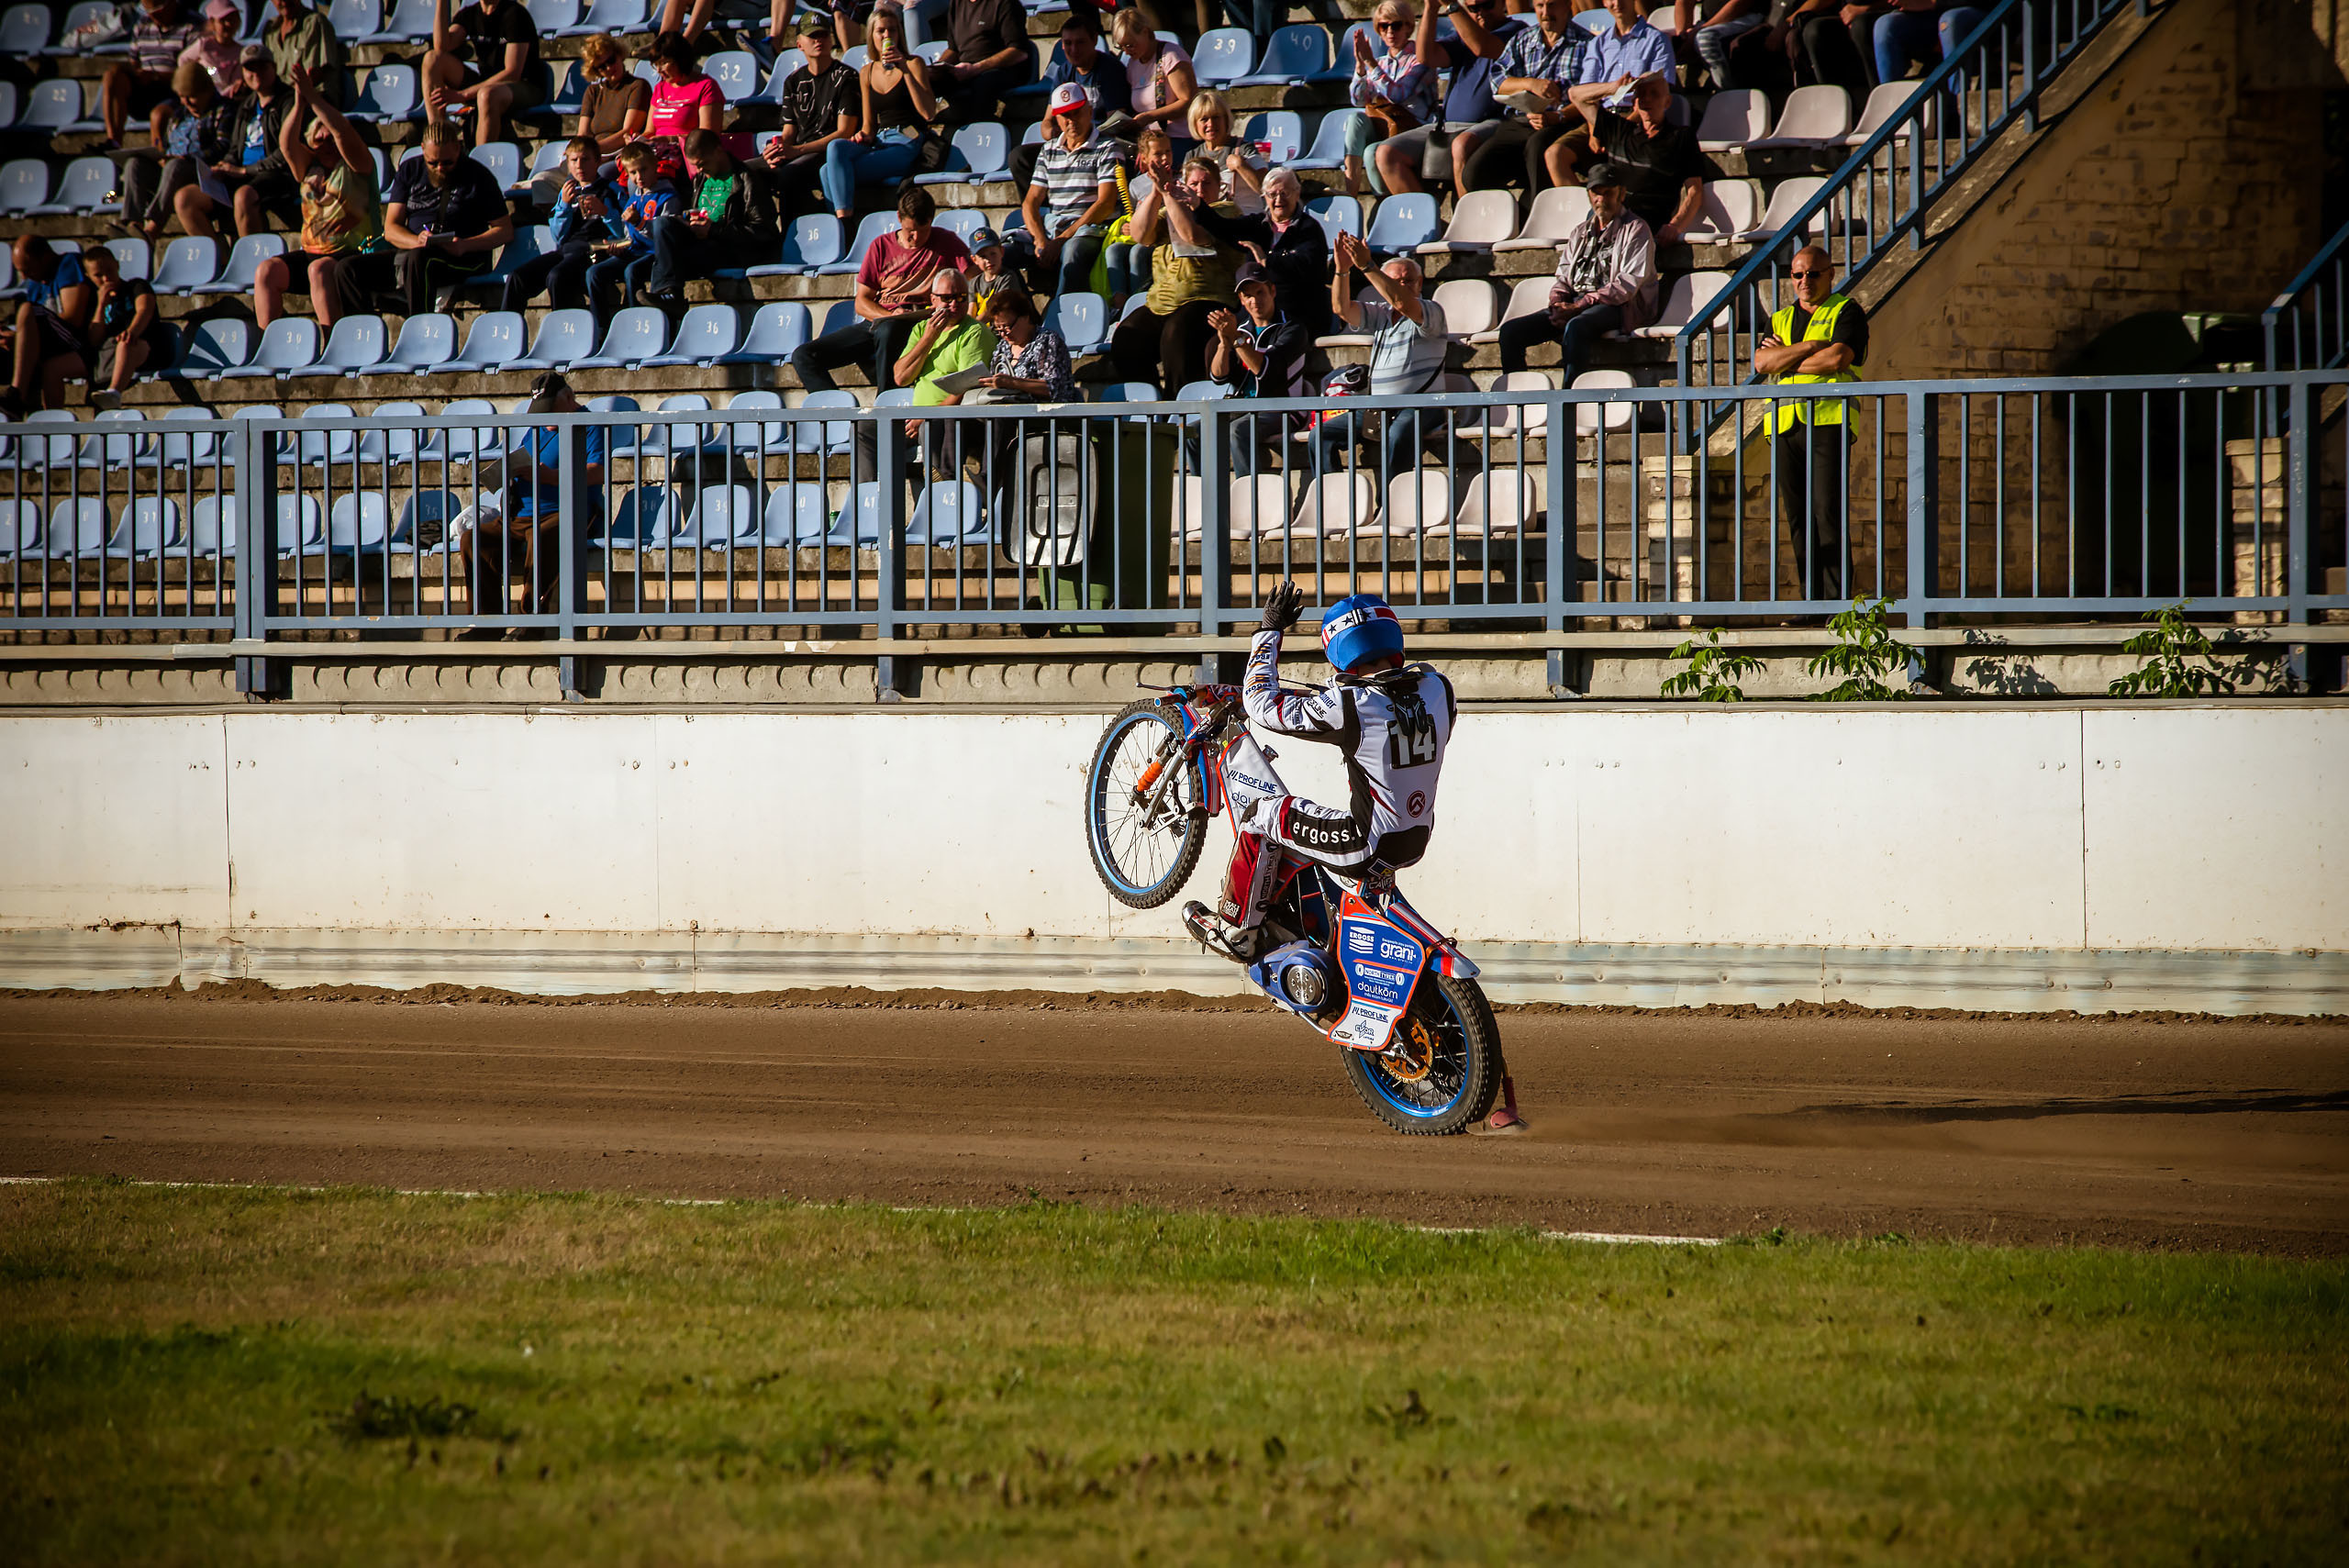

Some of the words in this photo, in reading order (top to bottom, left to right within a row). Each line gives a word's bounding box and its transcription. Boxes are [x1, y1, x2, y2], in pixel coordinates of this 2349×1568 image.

[1214, 39, 1236, 54] 39
[1291, 31, 1312, 50] 40
[720, 62, 742, 82] 32
[384, 74, 398, 88] 27
[977, 135, 991, 148] 37
[1398, 207, 1413, 220] 44
[808, 228, 819, 241] 36
[562, 322, 574, 338] 34
[636, 320, 650, 334] 35
[707, 321, 718, 334] 36
[864, 497, 874, 508] 41
[943, 491, 954, 506] 42
[1390, 725, 1435, 766] 14
[1349, 931, 1375, 942] ERGOSS
